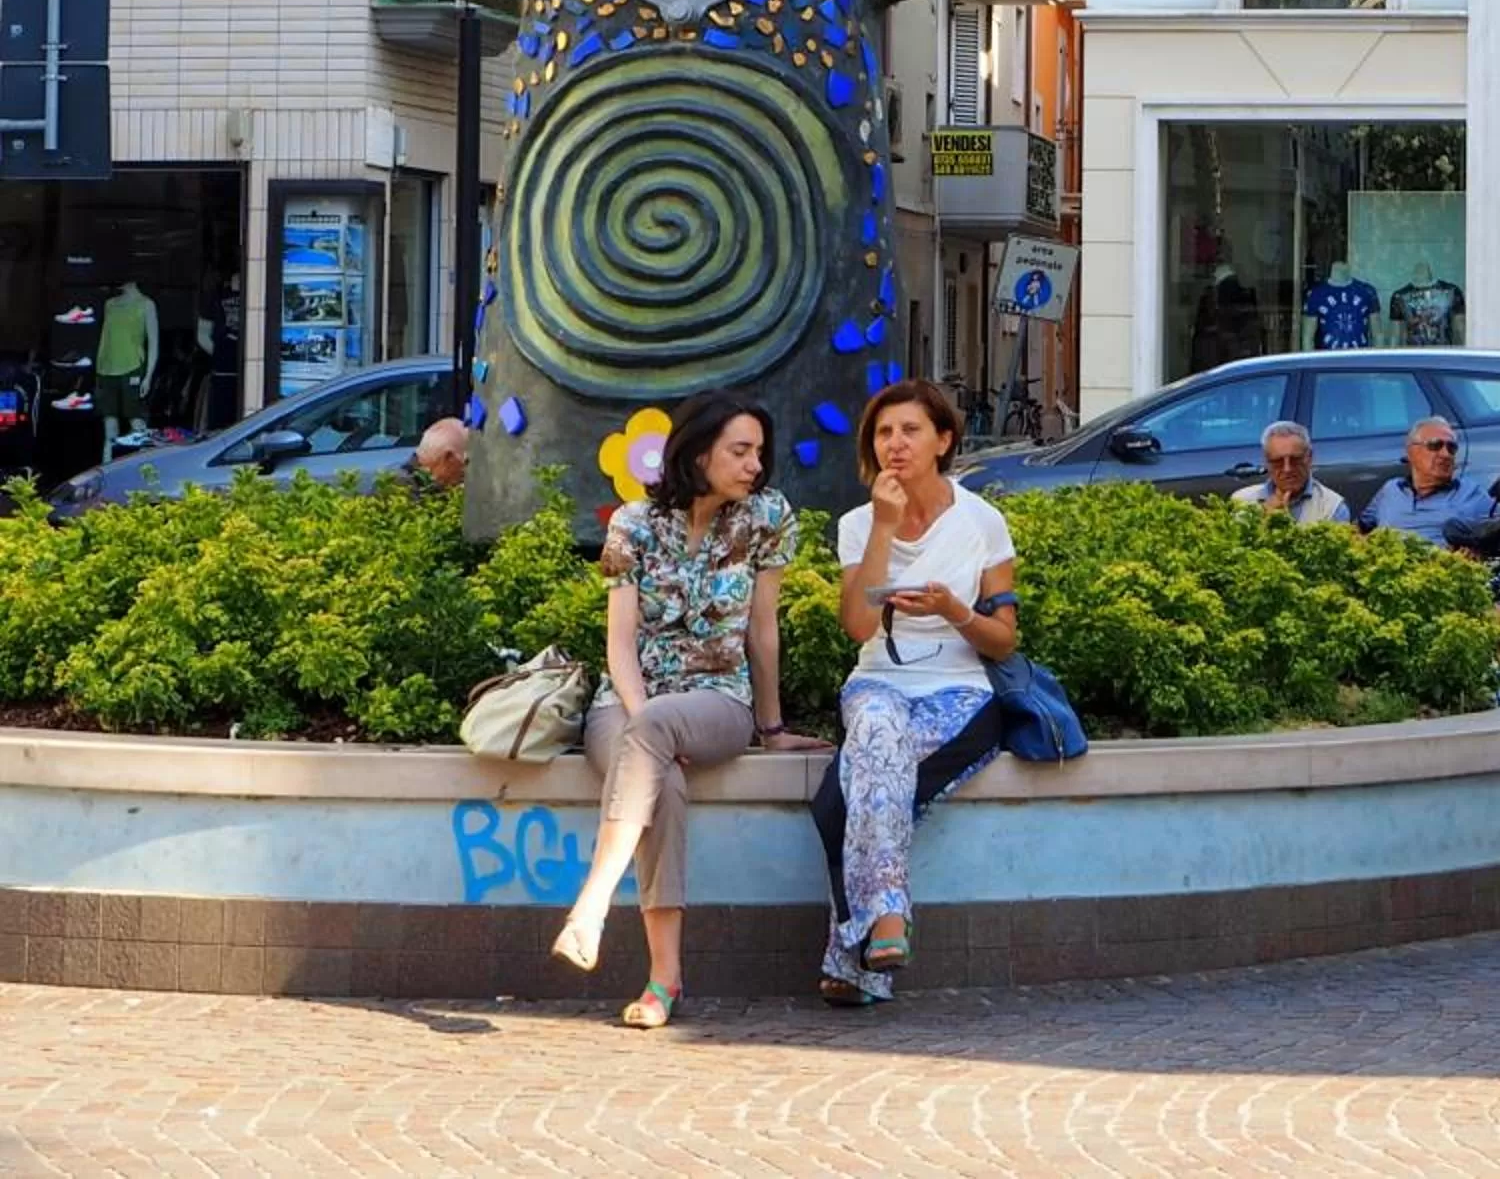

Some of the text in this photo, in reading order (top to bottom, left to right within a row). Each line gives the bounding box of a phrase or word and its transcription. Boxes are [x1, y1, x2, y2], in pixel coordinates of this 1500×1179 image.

[933, 134, 991, 151] VENDESI
[1031, 245, 1054, 255] area
[1015, 256, 1063, 270] pedonale
